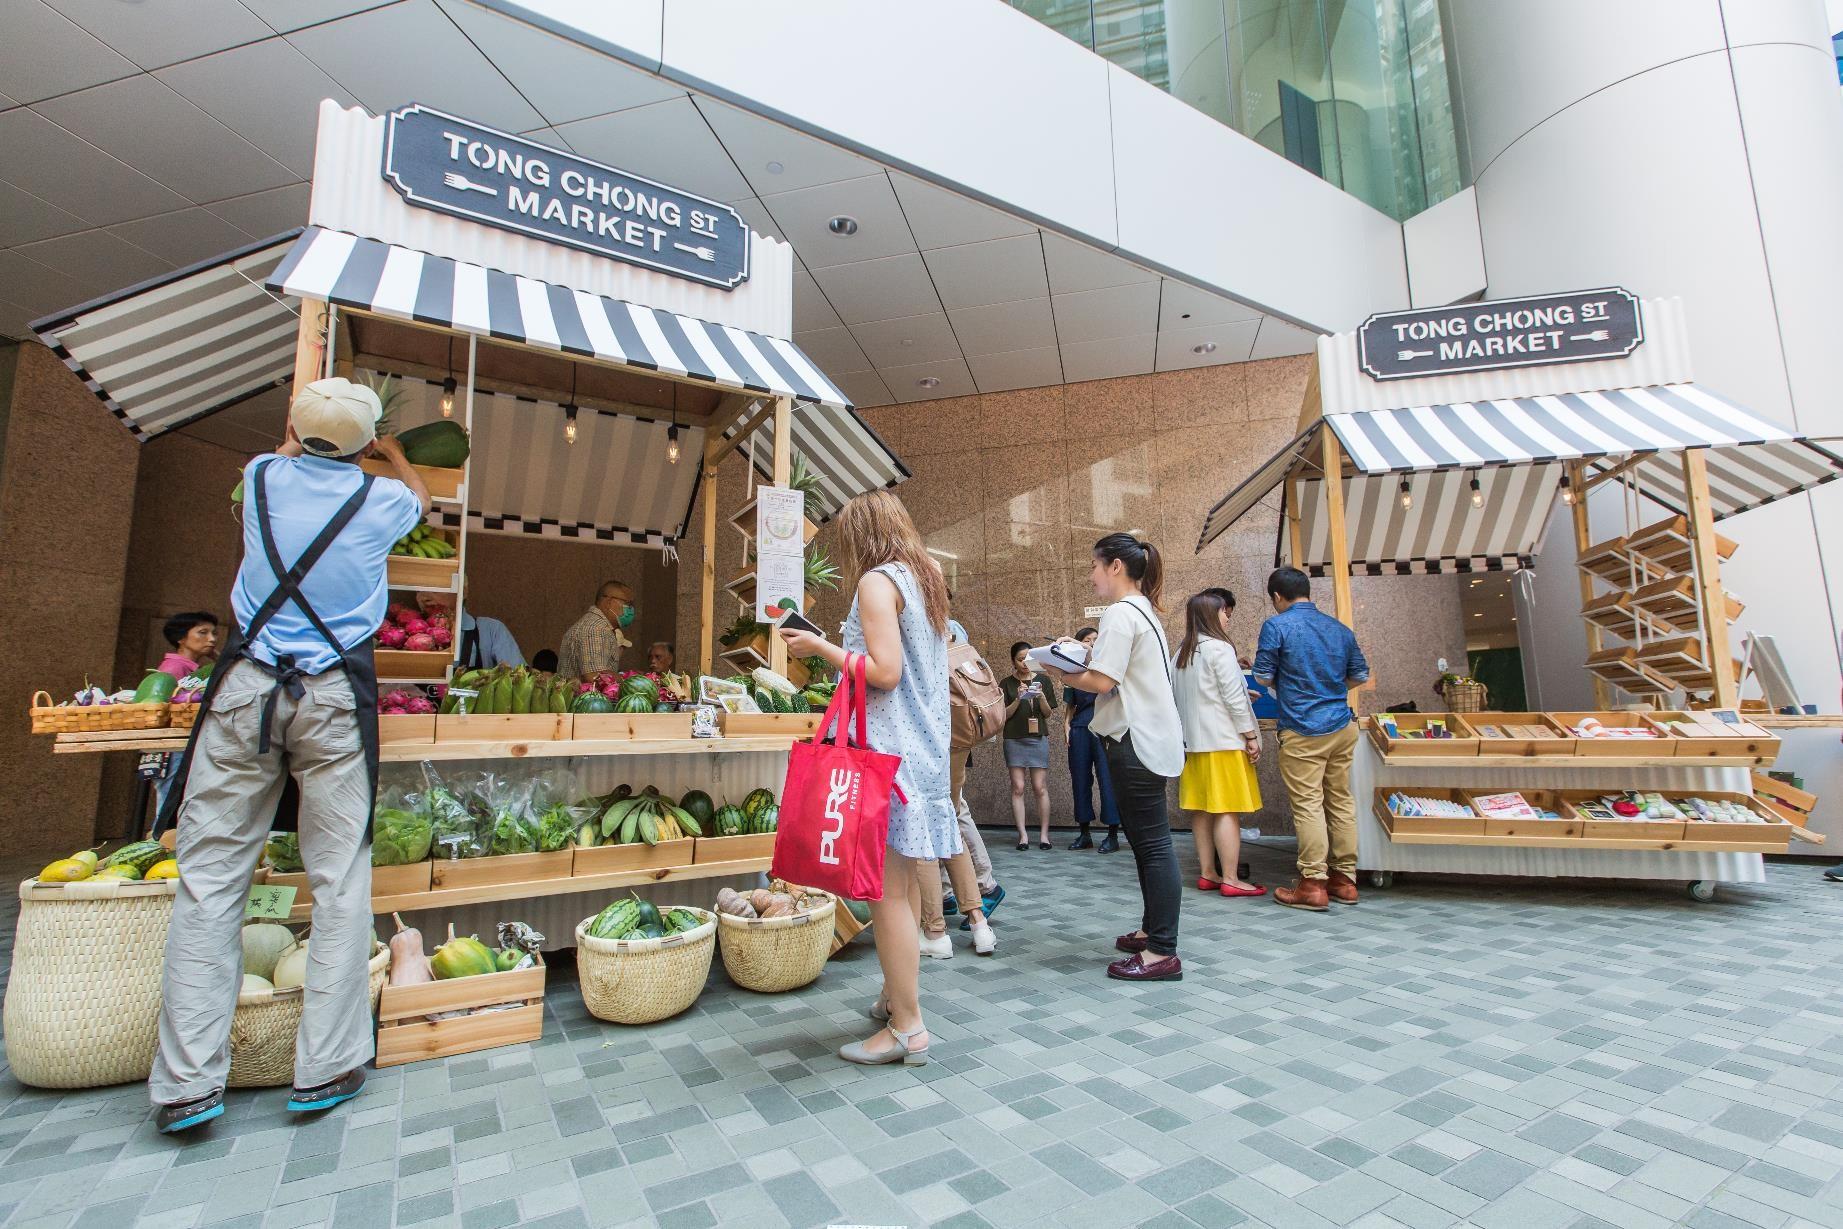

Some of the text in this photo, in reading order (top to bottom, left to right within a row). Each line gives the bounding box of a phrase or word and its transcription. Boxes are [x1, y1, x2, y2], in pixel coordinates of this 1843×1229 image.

[443, 132, 719, 236] TONG CHONG ST
[508, 186, 667, 252] MARKET
[1392, 301, 1608, 342] TONG CHONG ST
[1440, 331, 1563, 361] MARKET
[820, 768, 852, 865] PURE
